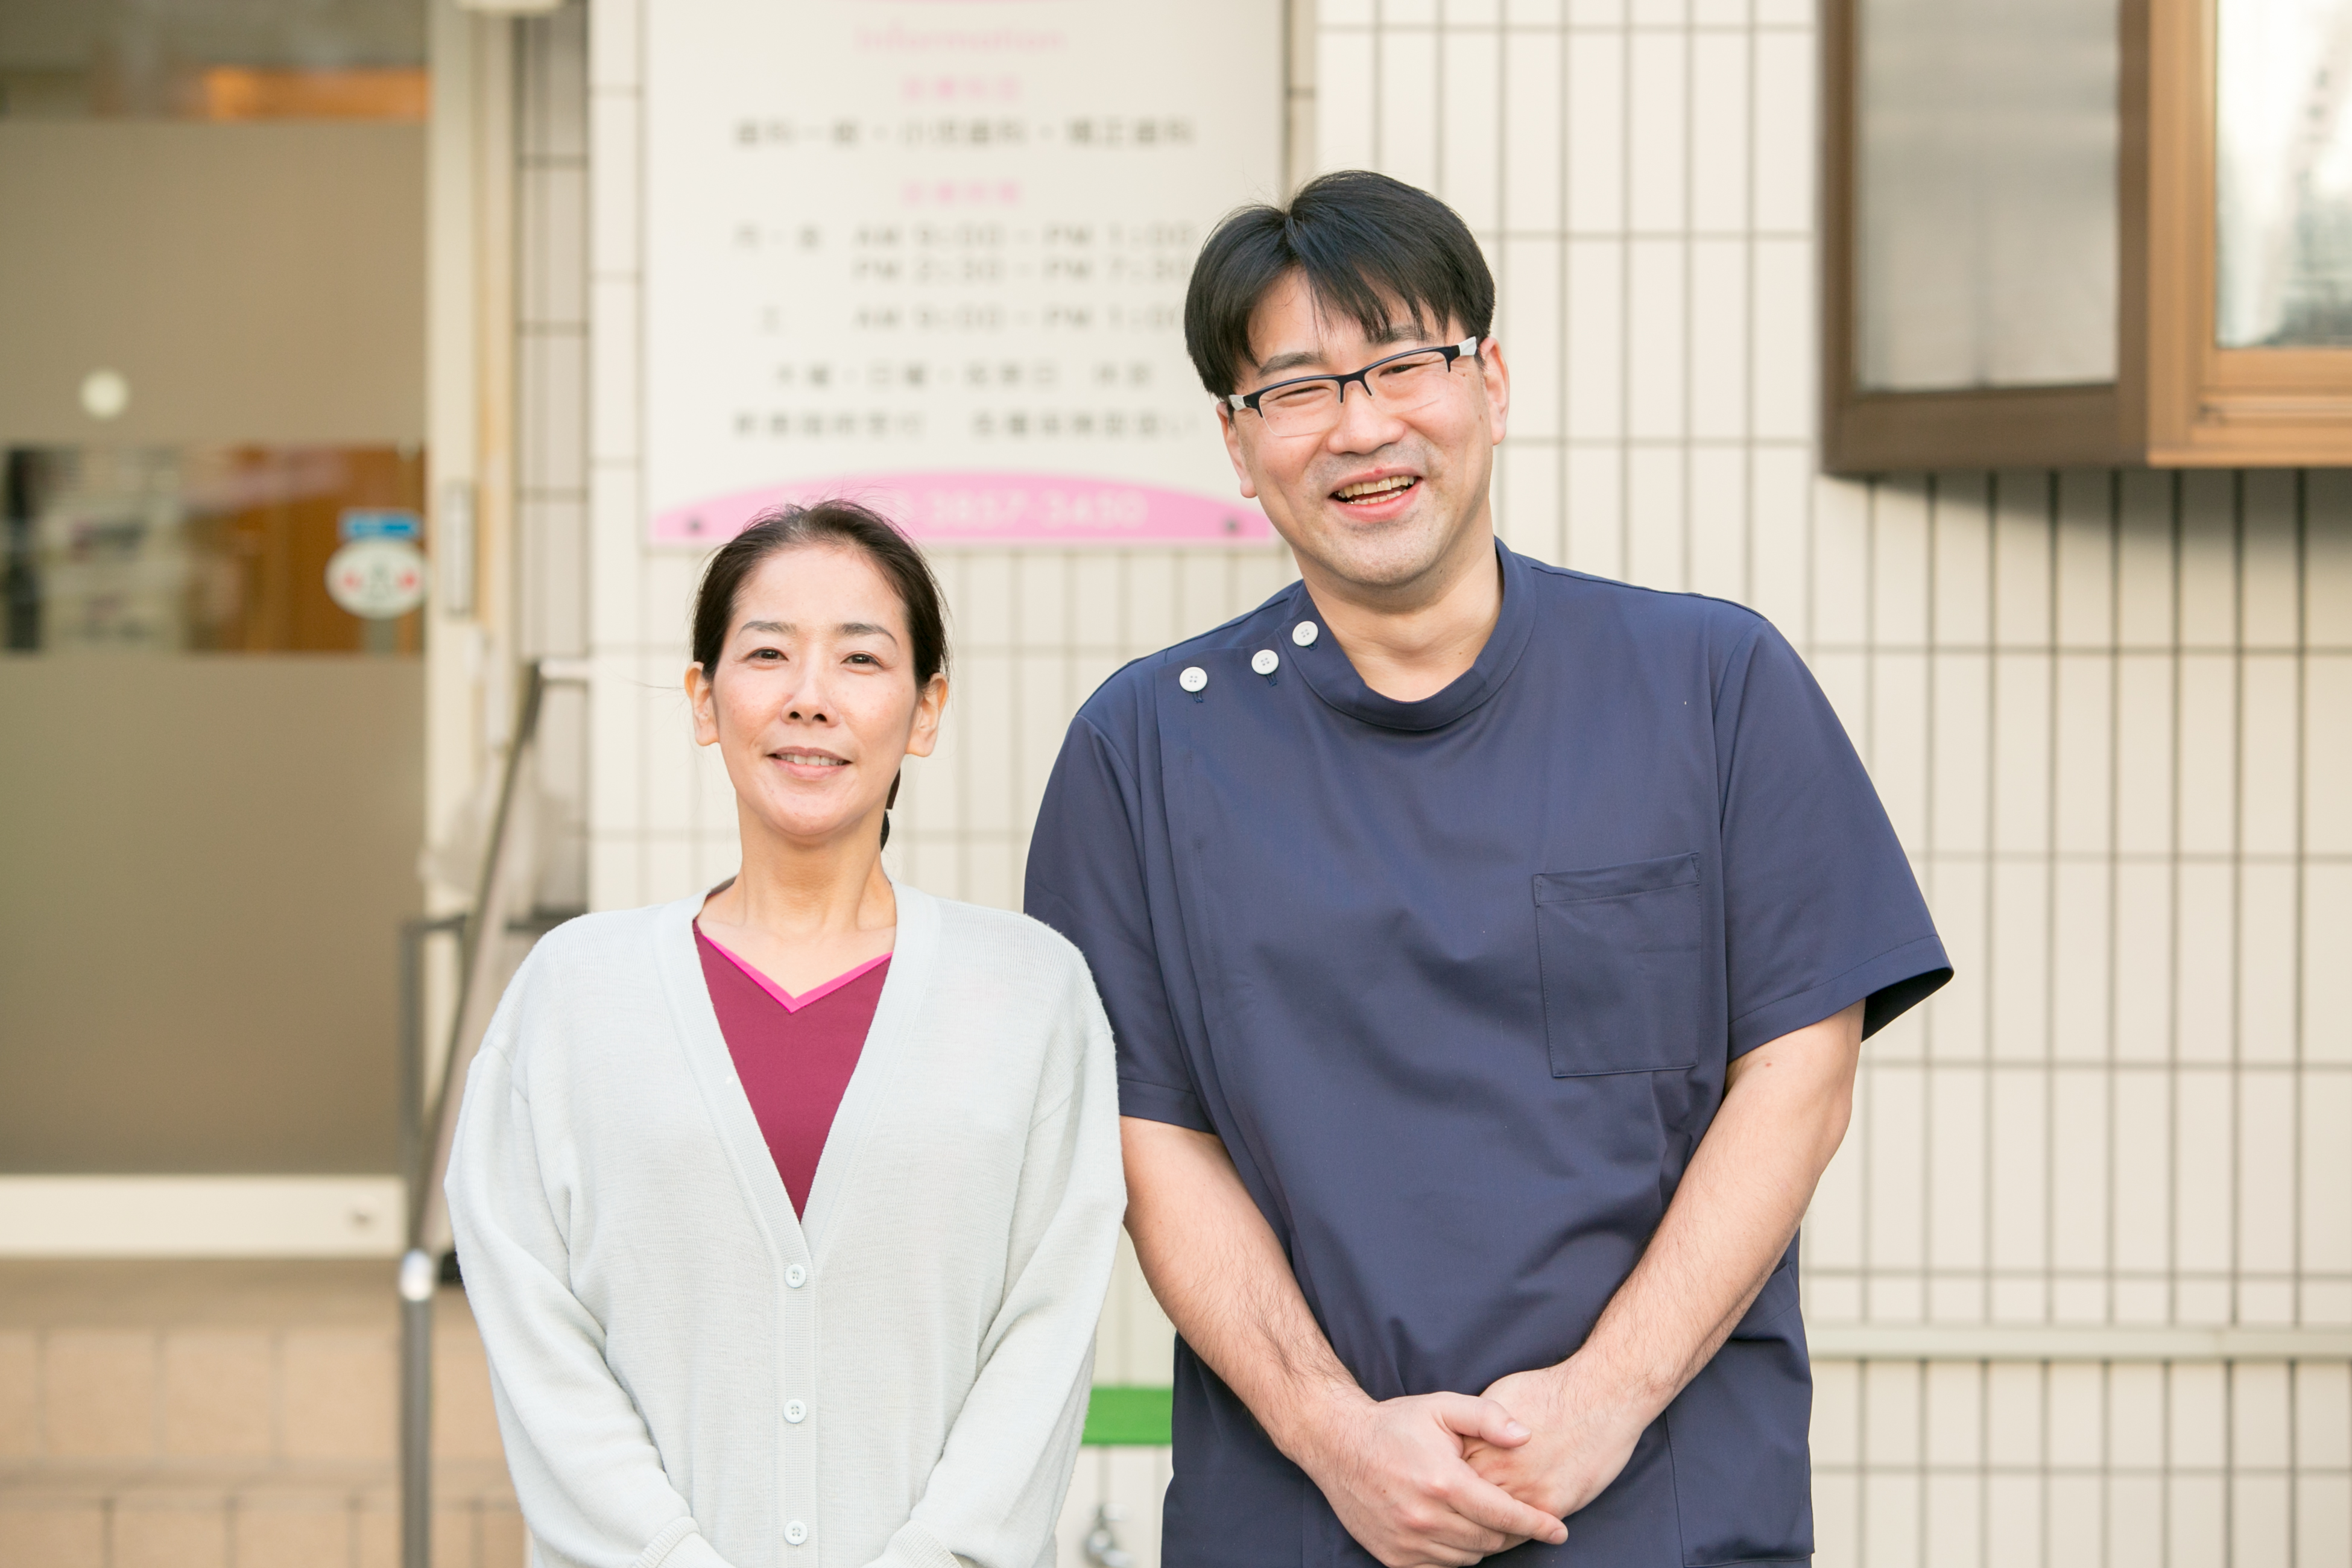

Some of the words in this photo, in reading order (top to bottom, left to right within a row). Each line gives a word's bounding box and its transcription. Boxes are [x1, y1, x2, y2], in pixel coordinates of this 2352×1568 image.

[854, 22, 1066, 53] Information
[853, 223, 902, 248] AM
[914, 223, 1004, 250] 9:00
[1043, 223, 1092, 248] PM
[853, 256, 902, 282] PM
[914, 256, 1004, 285] 2:30
[1043, 256, 1092, 282] PM
[853, 304, 902, 331] AM
[914, 304, 1004, 332] 9:00
[1043, 304, 1092, 331] PM
